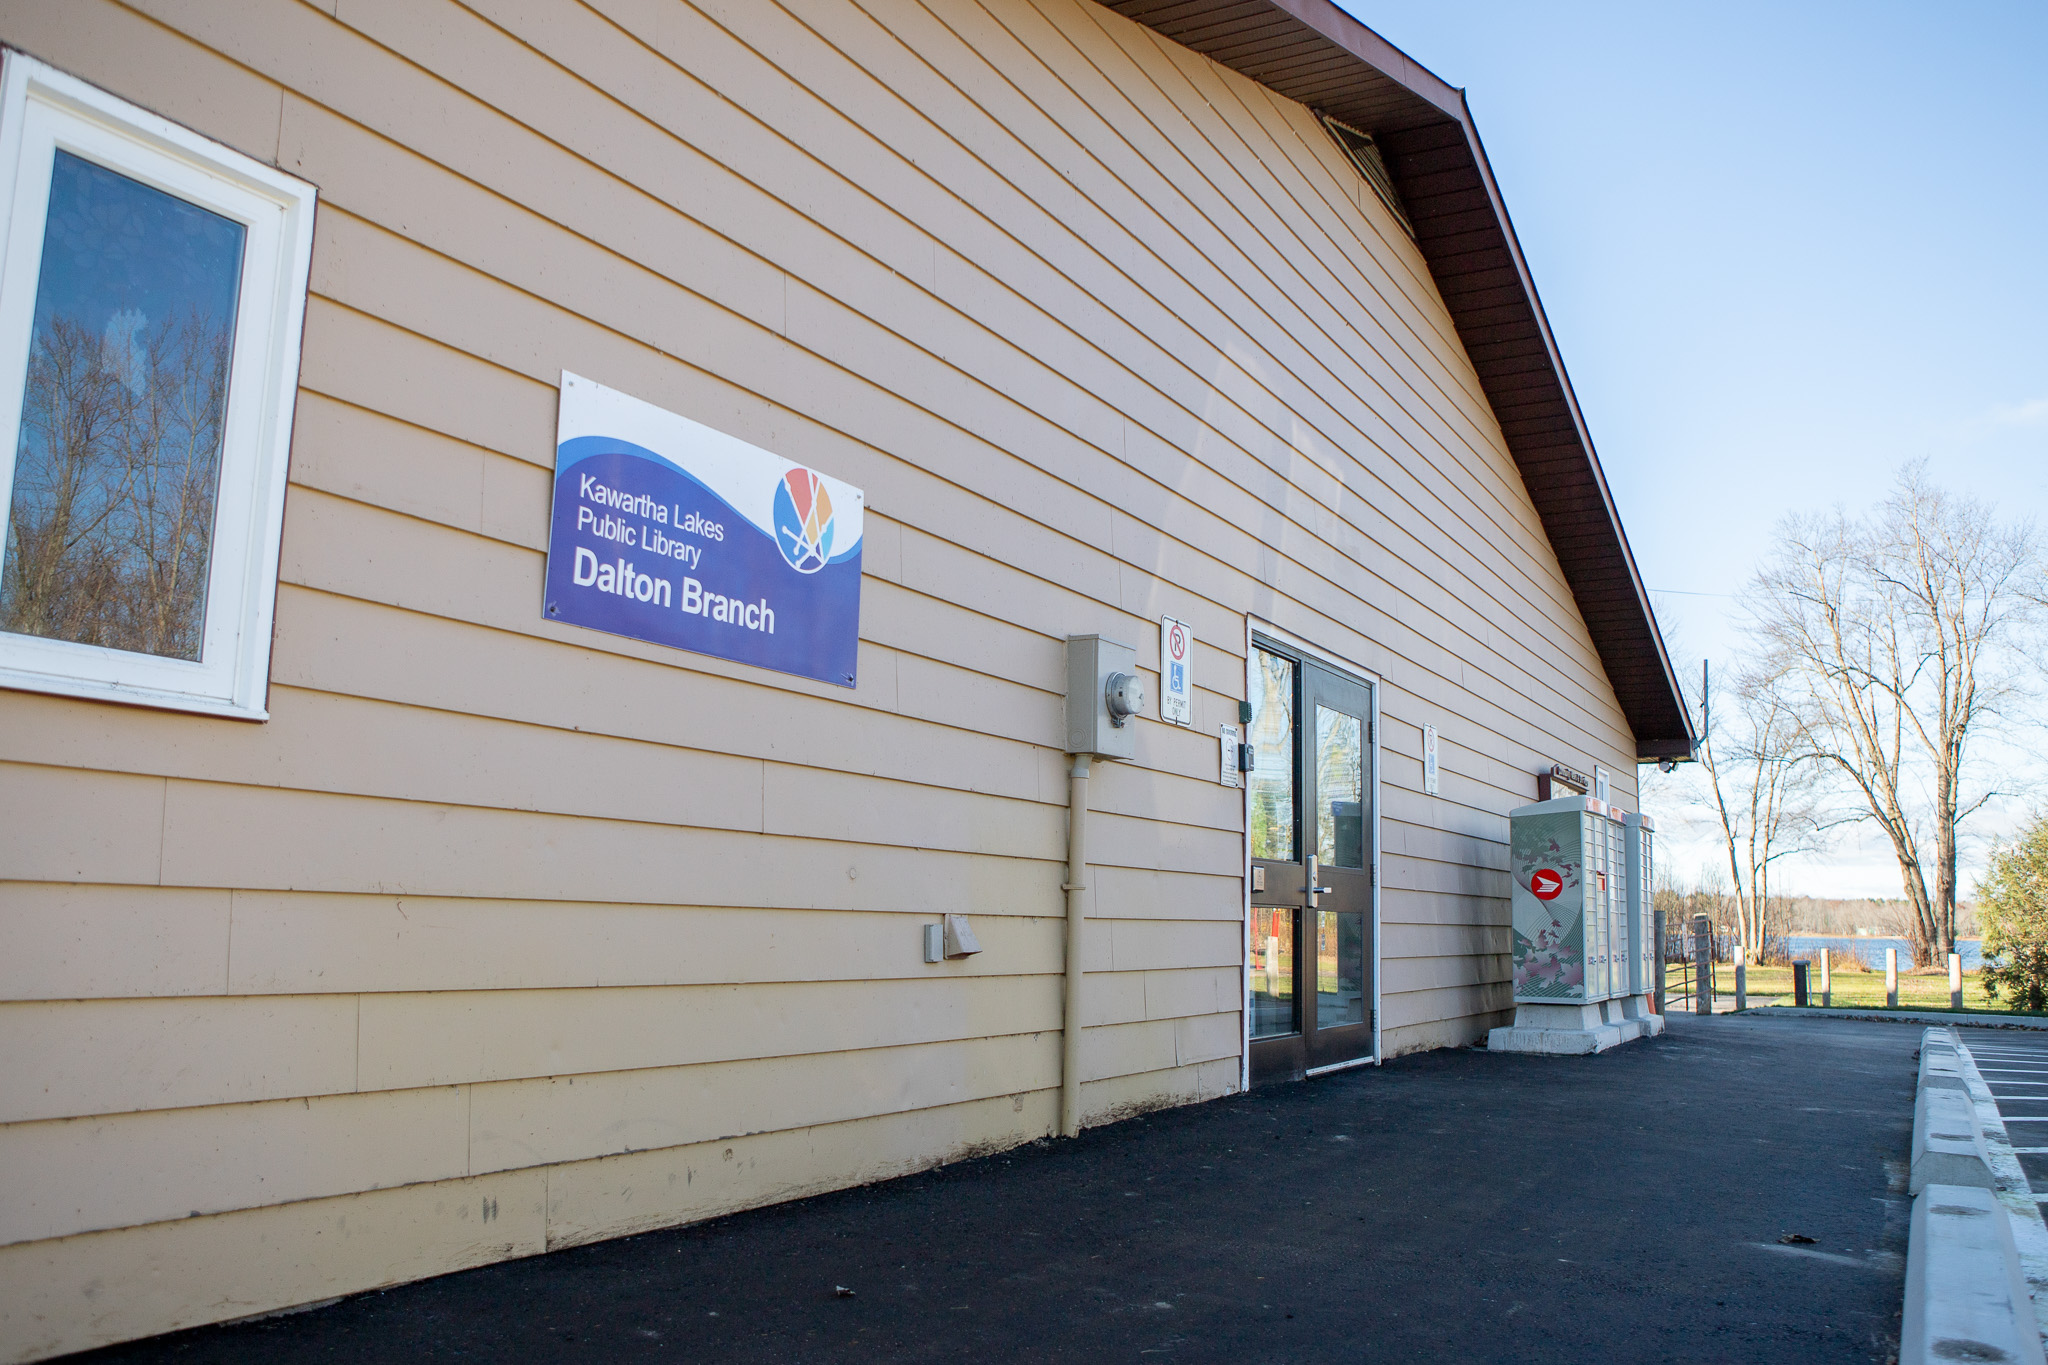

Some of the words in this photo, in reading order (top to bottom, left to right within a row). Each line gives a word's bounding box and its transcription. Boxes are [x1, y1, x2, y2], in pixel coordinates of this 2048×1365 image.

[577, 505, 637, 546] Public
[641, 525, 702, 570] Library
[580, 472, 668, 524] Kawartha
[674, 504, 725, 542] Lakes
[573, 546, 672, 608] Dalton
[682, 576, 775, 634] Branch
